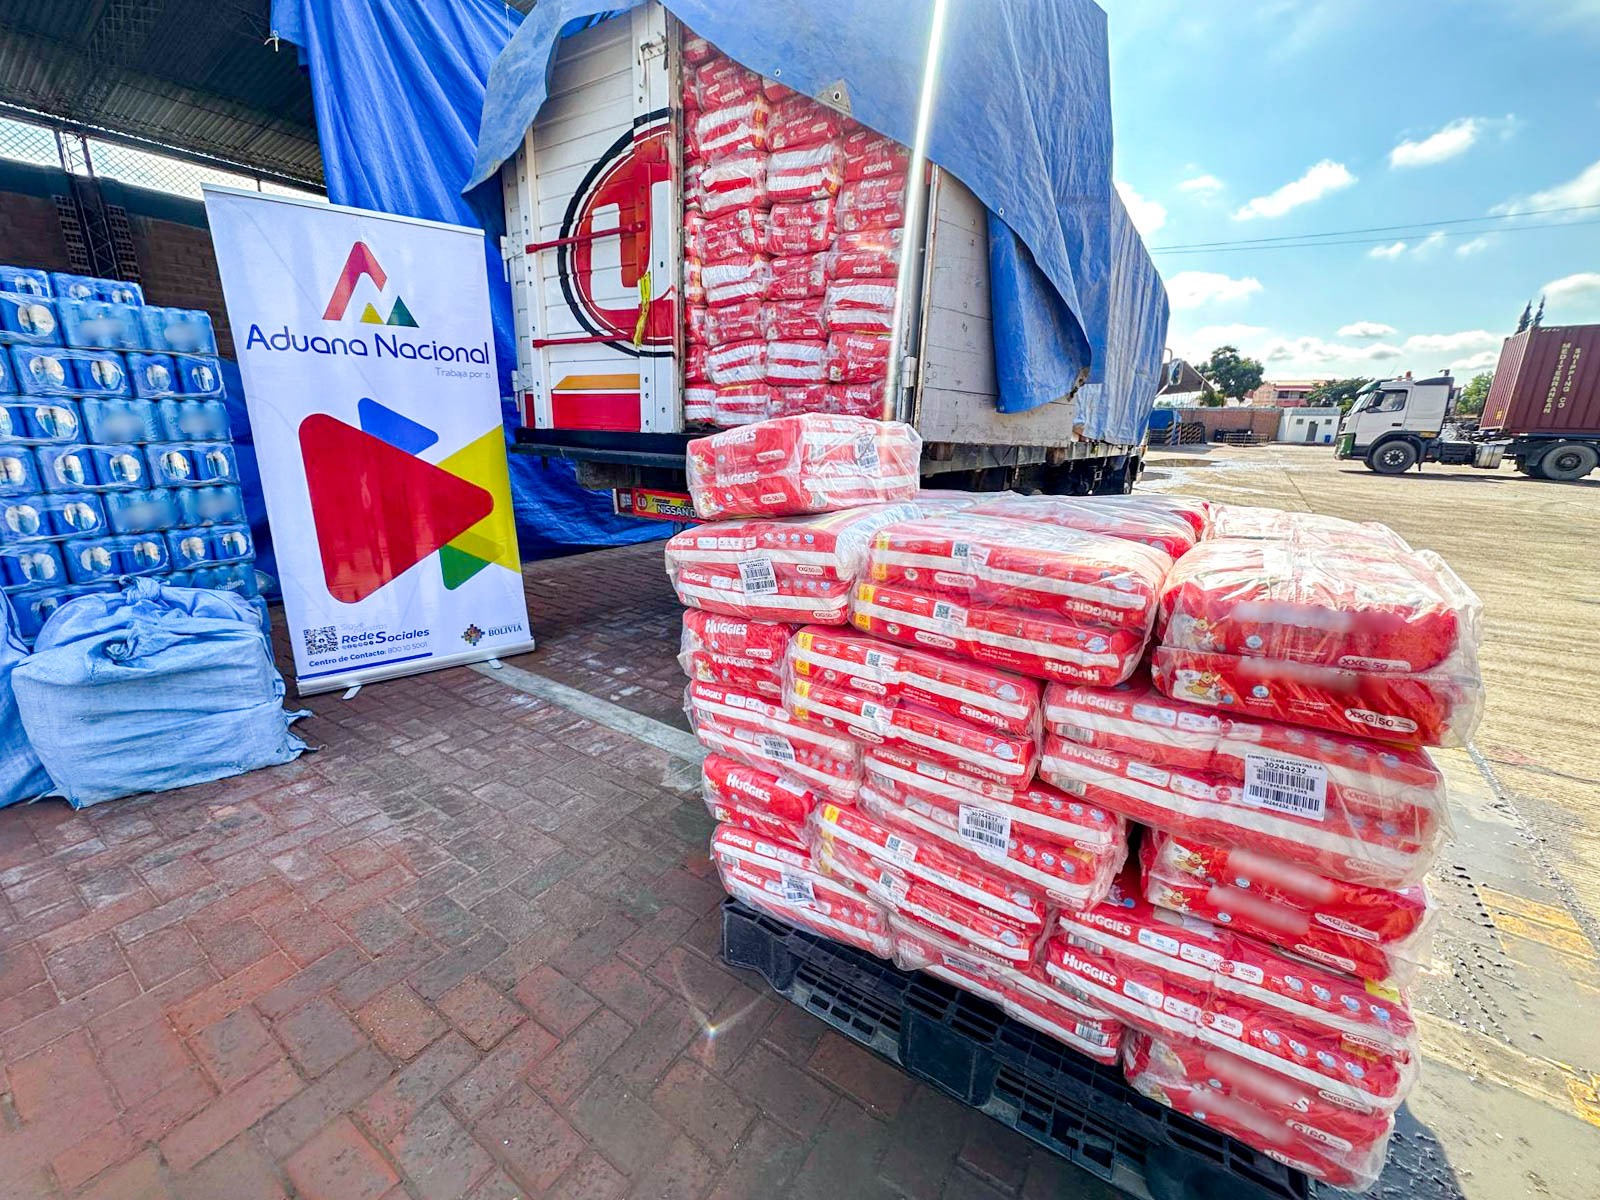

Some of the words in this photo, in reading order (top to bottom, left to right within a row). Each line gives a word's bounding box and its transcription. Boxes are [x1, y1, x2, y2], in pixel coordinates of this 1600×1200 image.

[246, 323, 368, 357] Aduana
[374, 333, 490, 365] Nacional
[434, 367, 467, 379] Trabaja
[469, 371, 483, 380] por
[1543, 343, 1571, 413] MEDITERRANEAN
[1562, 348, 1581, 392] SHIPPING
[1558, 397, 1567, 408] CO
[657, 503, 689, 517] NISSAN
[1064, 599, 1124, 622] HUGGIES
[488, 624, 522, 637] BOLIVIA
[704, 619, 748, 636] HUGGIES
[309, 658, 337, 667] Centro
[338, 655, 349, 663] de
[1045, 661, 1099, 681] HUGGIES
[696, 685, 723, 700] HUGGIES
[1066, 690, 1126, 713] HUGGIES
[960, 706, 1009, 728] HUGGIES
[1062, 742, 1120, 769] HUGGIES
[959, 761, 1007, 784] HUGGIES
[1264, 762, 1307, 774] 30244232
[727, 773, 771, 802] HUGGIES
[722, 832, 752, 848] HUGGIES
[1075, 911, 1131, 936] HUGGIES
[1063, 952, 1117, 987] HUGGIES
